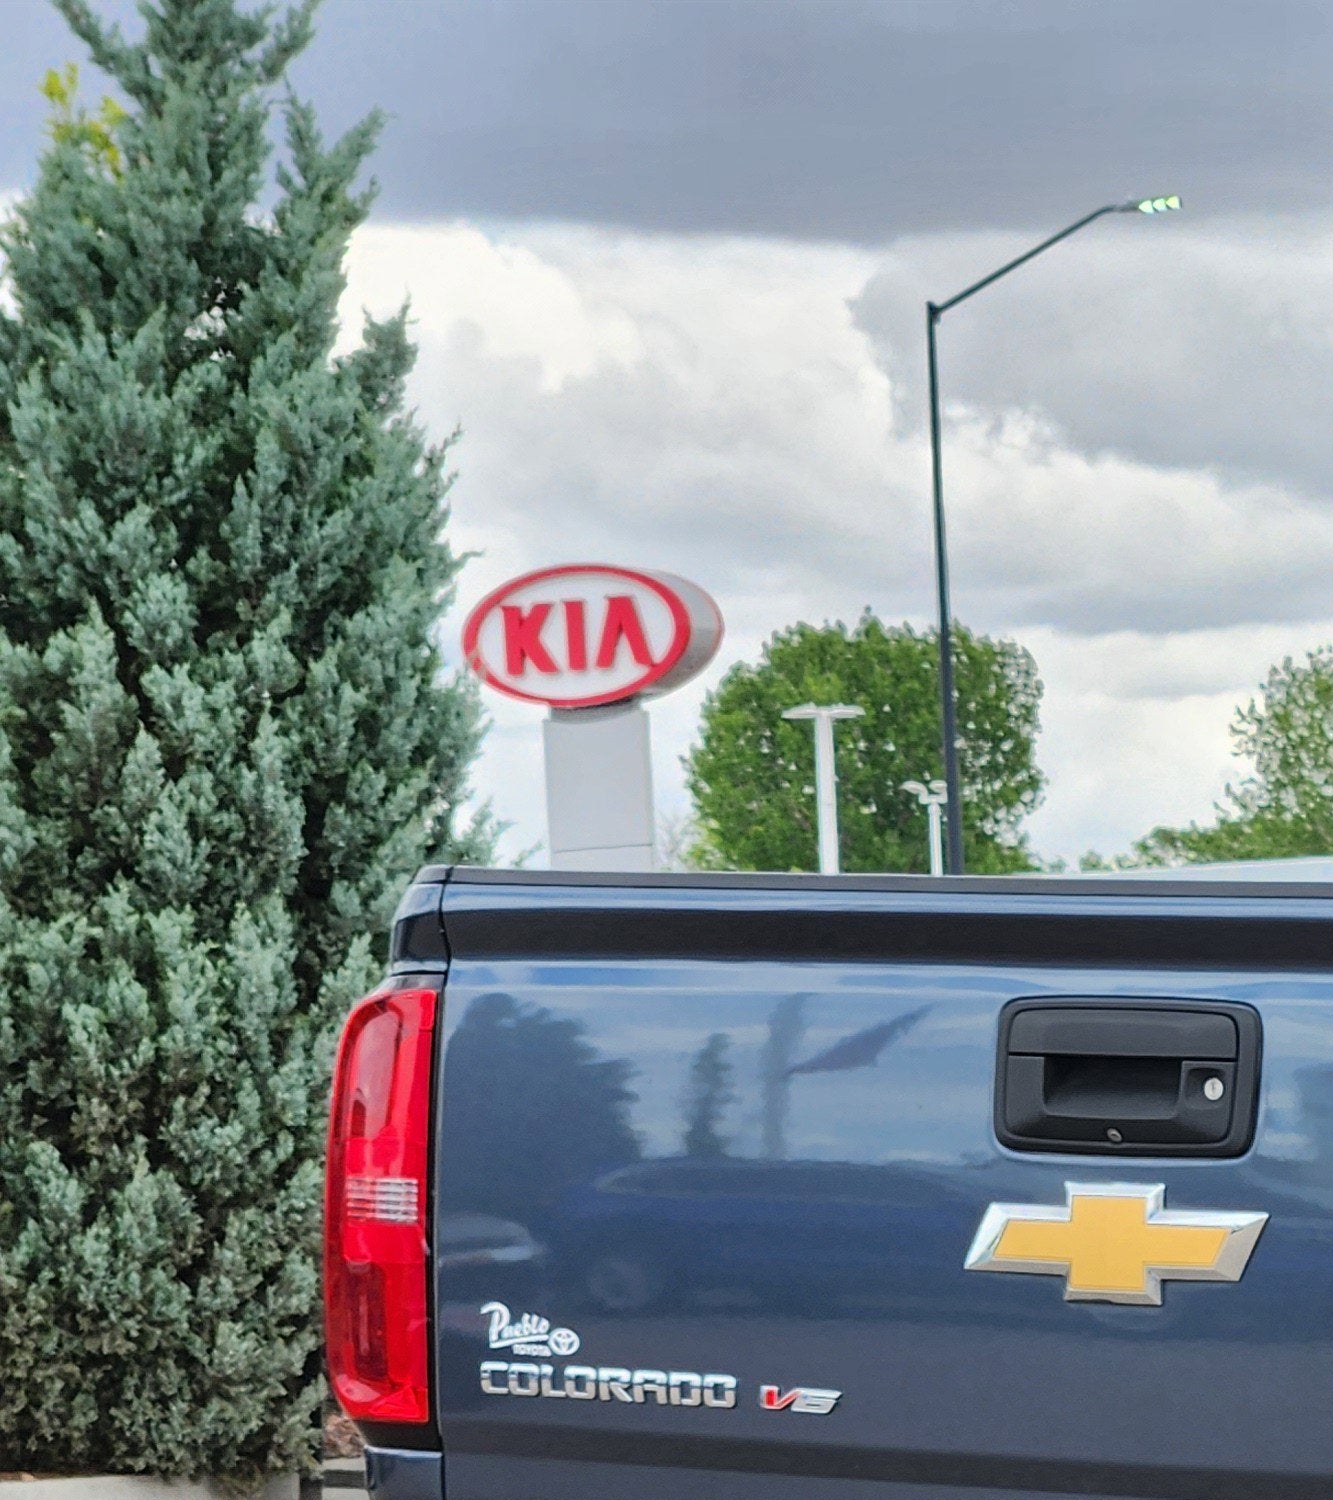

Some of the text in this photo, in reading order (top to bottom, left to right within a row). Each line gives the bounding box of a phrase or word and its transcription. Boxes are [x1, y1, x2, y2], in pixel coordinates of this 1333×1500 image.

[502, 595, 655, 677] KIA
[480, 1360, 843, 1415] COLORADO V6
